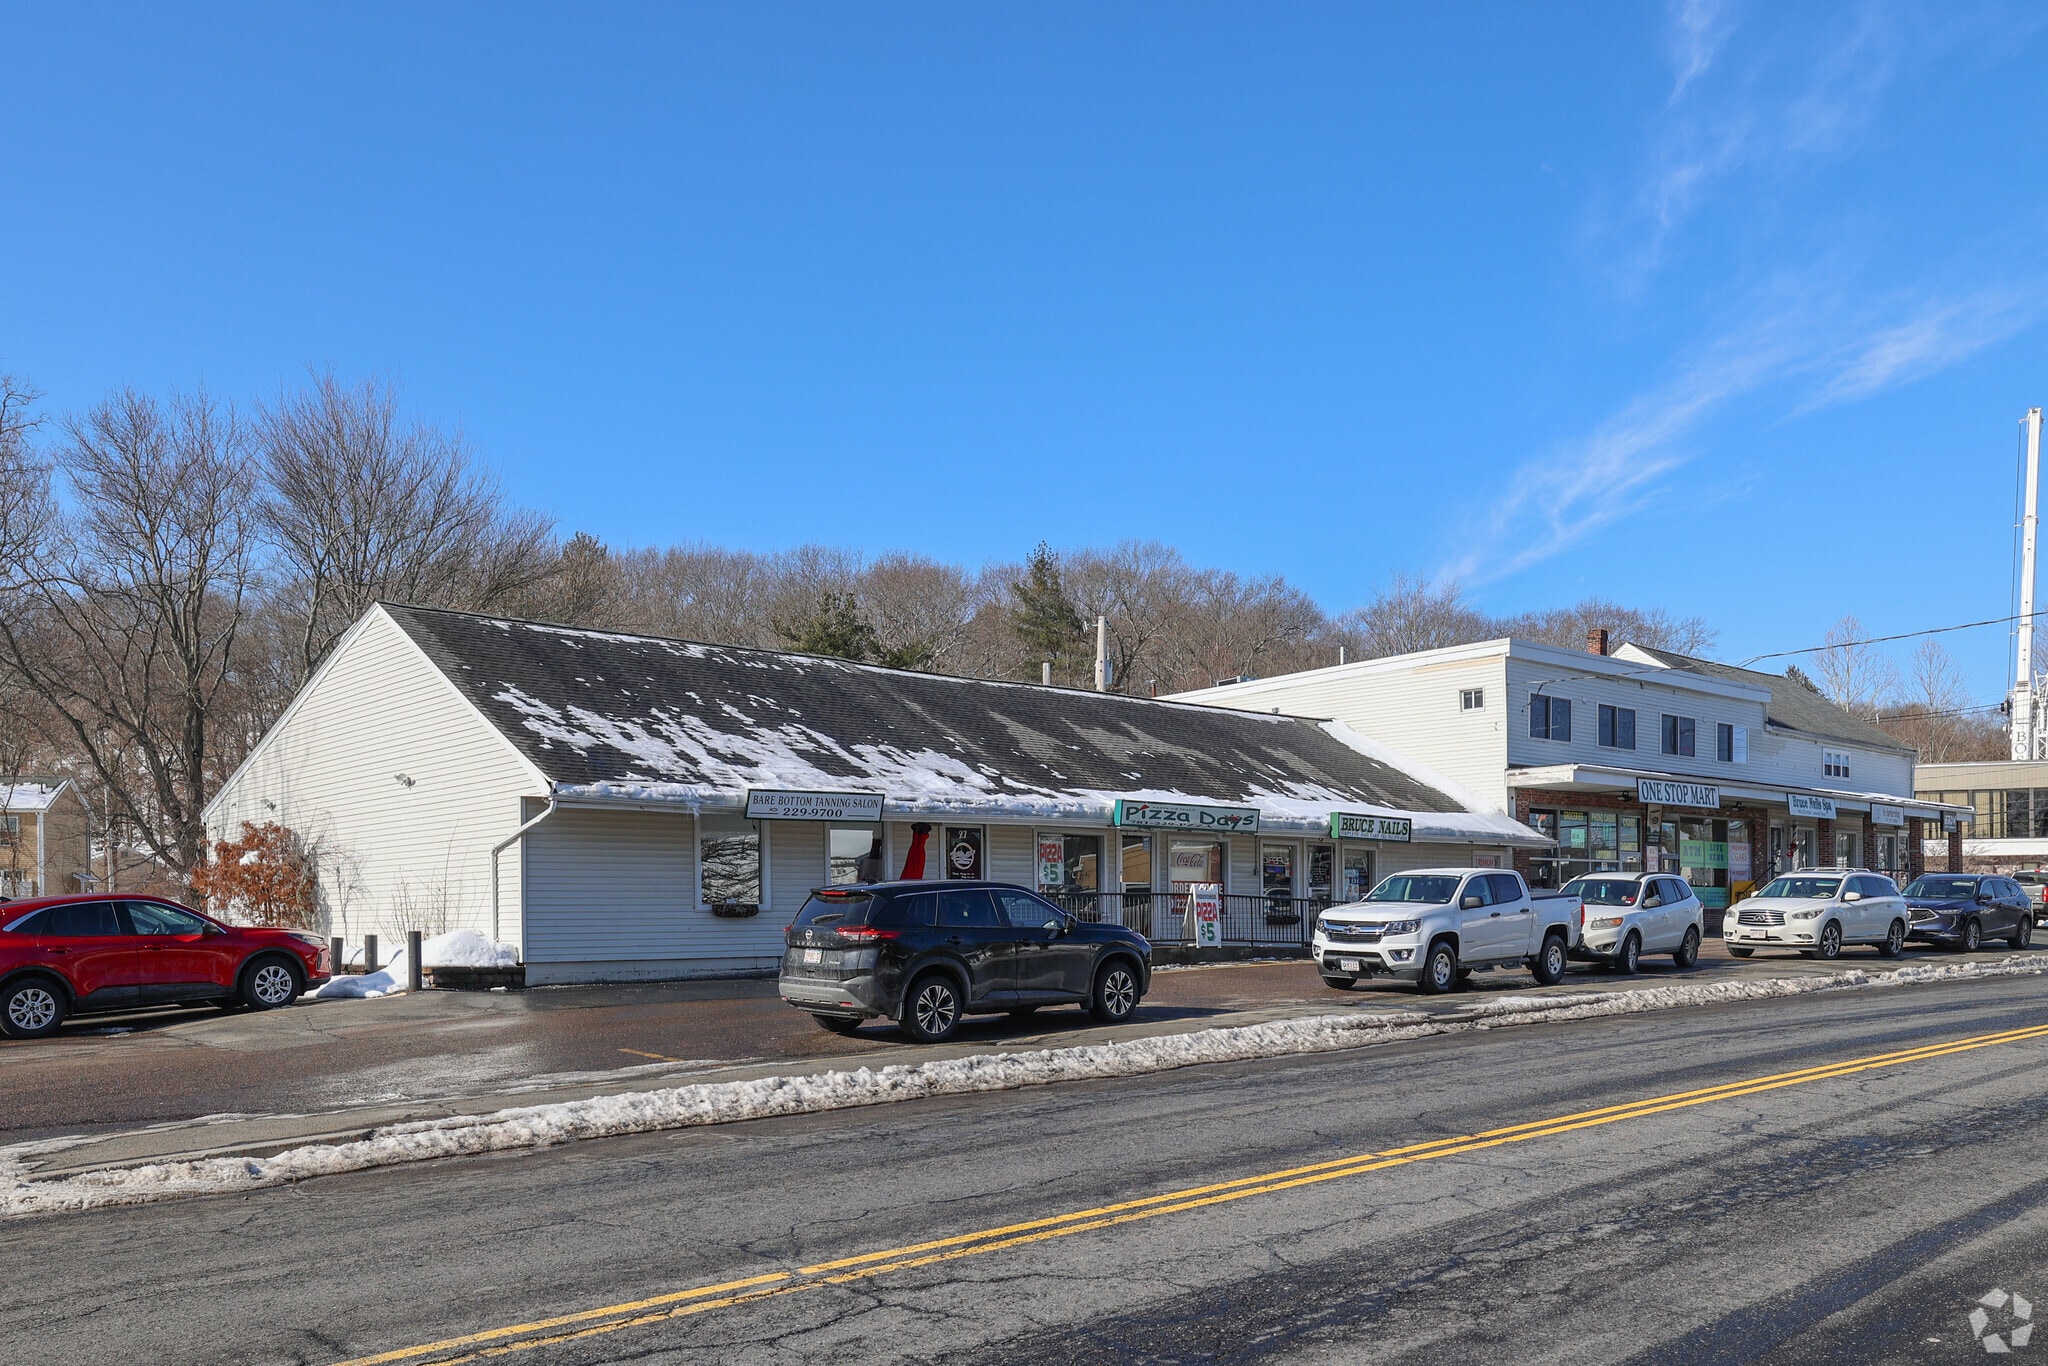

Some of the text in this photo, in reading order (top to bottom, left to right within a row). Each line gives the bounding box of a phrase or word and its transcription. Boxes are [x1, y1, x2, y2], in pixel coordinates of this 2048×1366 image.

[753, 795, 879, 809] BARE BOTTOM TANNING SALON
[1641, 781, 1716, 806] ONE STOP MART
[783, 807, 843, 818] 229-9700
[1792, 796, 1808, 808] Bruce
[1808, 798, 1822, 810] Nails
[1822, 798, 1832, 814] Spa
[1126, 805, 1254, 830] Pizza Days
[1564, 812, 1584, 820] GROCERIES
[1592, 812, 1616, 822] PHONE CARDS
[1342, 817, 1408, 836] BRUCE NAILS
[1040, 843, 1063, 863] PIZZA
[1683, 846, 1701, 856] ATM
[1732, 852, 1748, 862] CIGARS
[1476, 858, 1494, 866] PREMIUM
[1044, 864, 1058, 882] $5
[1196, 902, 1218, 922] PIZZA
[1201, 922, 1215, 941] $5
